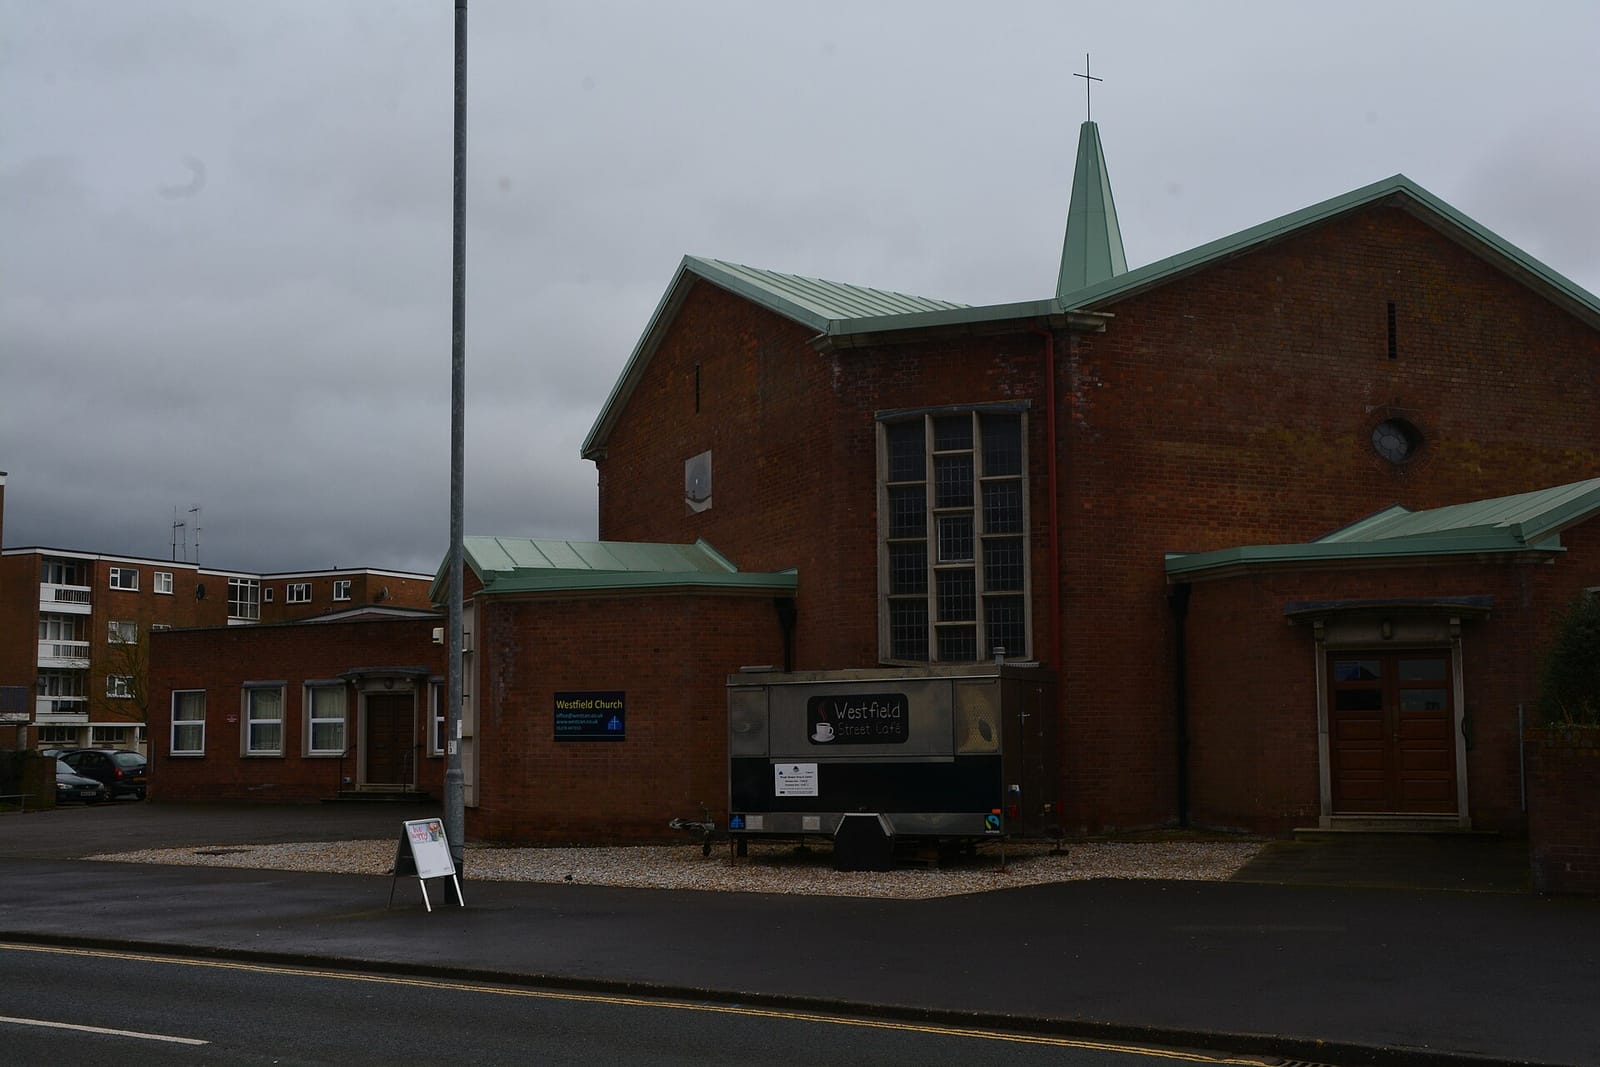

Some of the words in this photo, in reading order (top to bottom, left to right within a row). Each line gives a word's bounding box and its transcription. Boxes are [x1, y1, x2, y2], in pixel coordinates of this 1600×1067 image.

[556, 699, 593, 709] Westfield
[595, 699, 623, 709] Church
[834, 701, 901, 719] Westfield
[838, 722, 870, 736] Street
